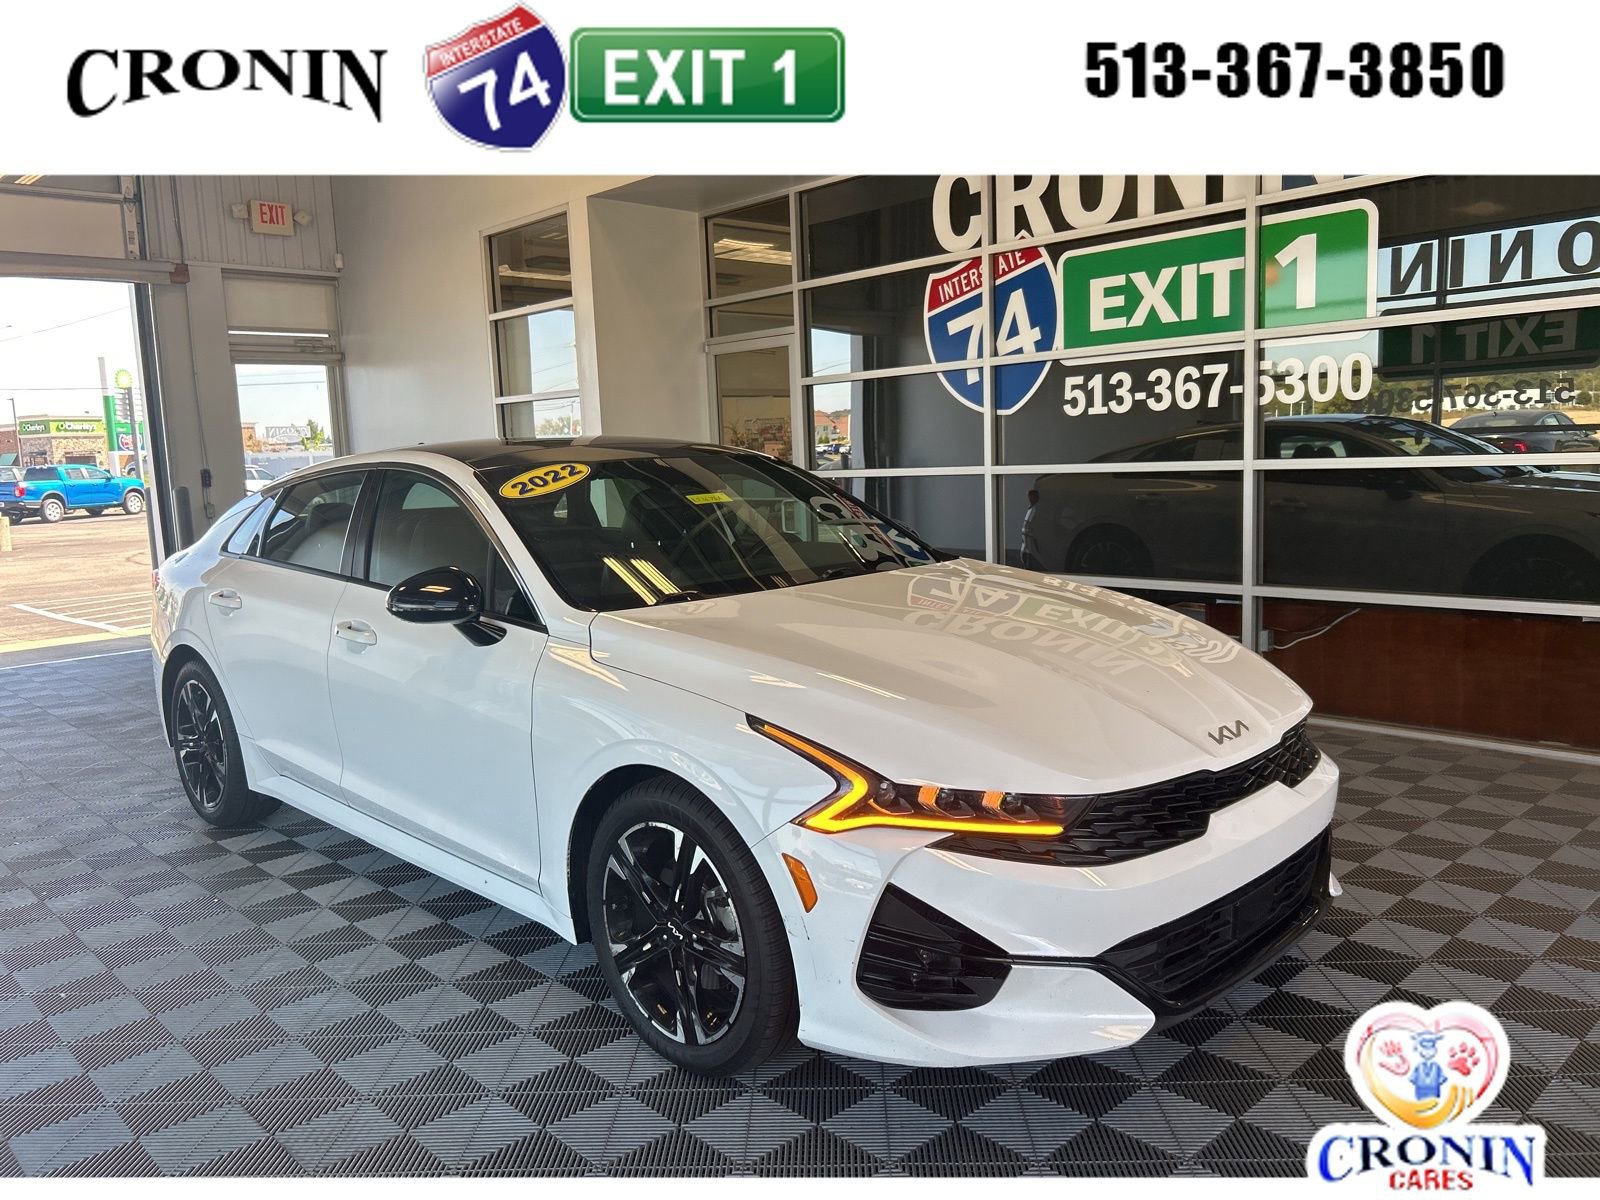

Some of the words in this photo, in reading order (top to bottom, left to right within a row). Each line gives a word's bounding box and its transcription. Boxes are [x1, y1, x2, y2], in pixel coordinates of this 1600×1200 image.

[259, 203, 286, 225] EXIT
[938, 250, 1026, 303] INTERATE
[1089, 256, 1246, 332] EXIT
[1274, 233, 1317, 310] 1
[946, 288, 1042, 386] 74
[1062, 352, 1374, 417] 513-367-5300
[510, 464, 583, 496] 2022
